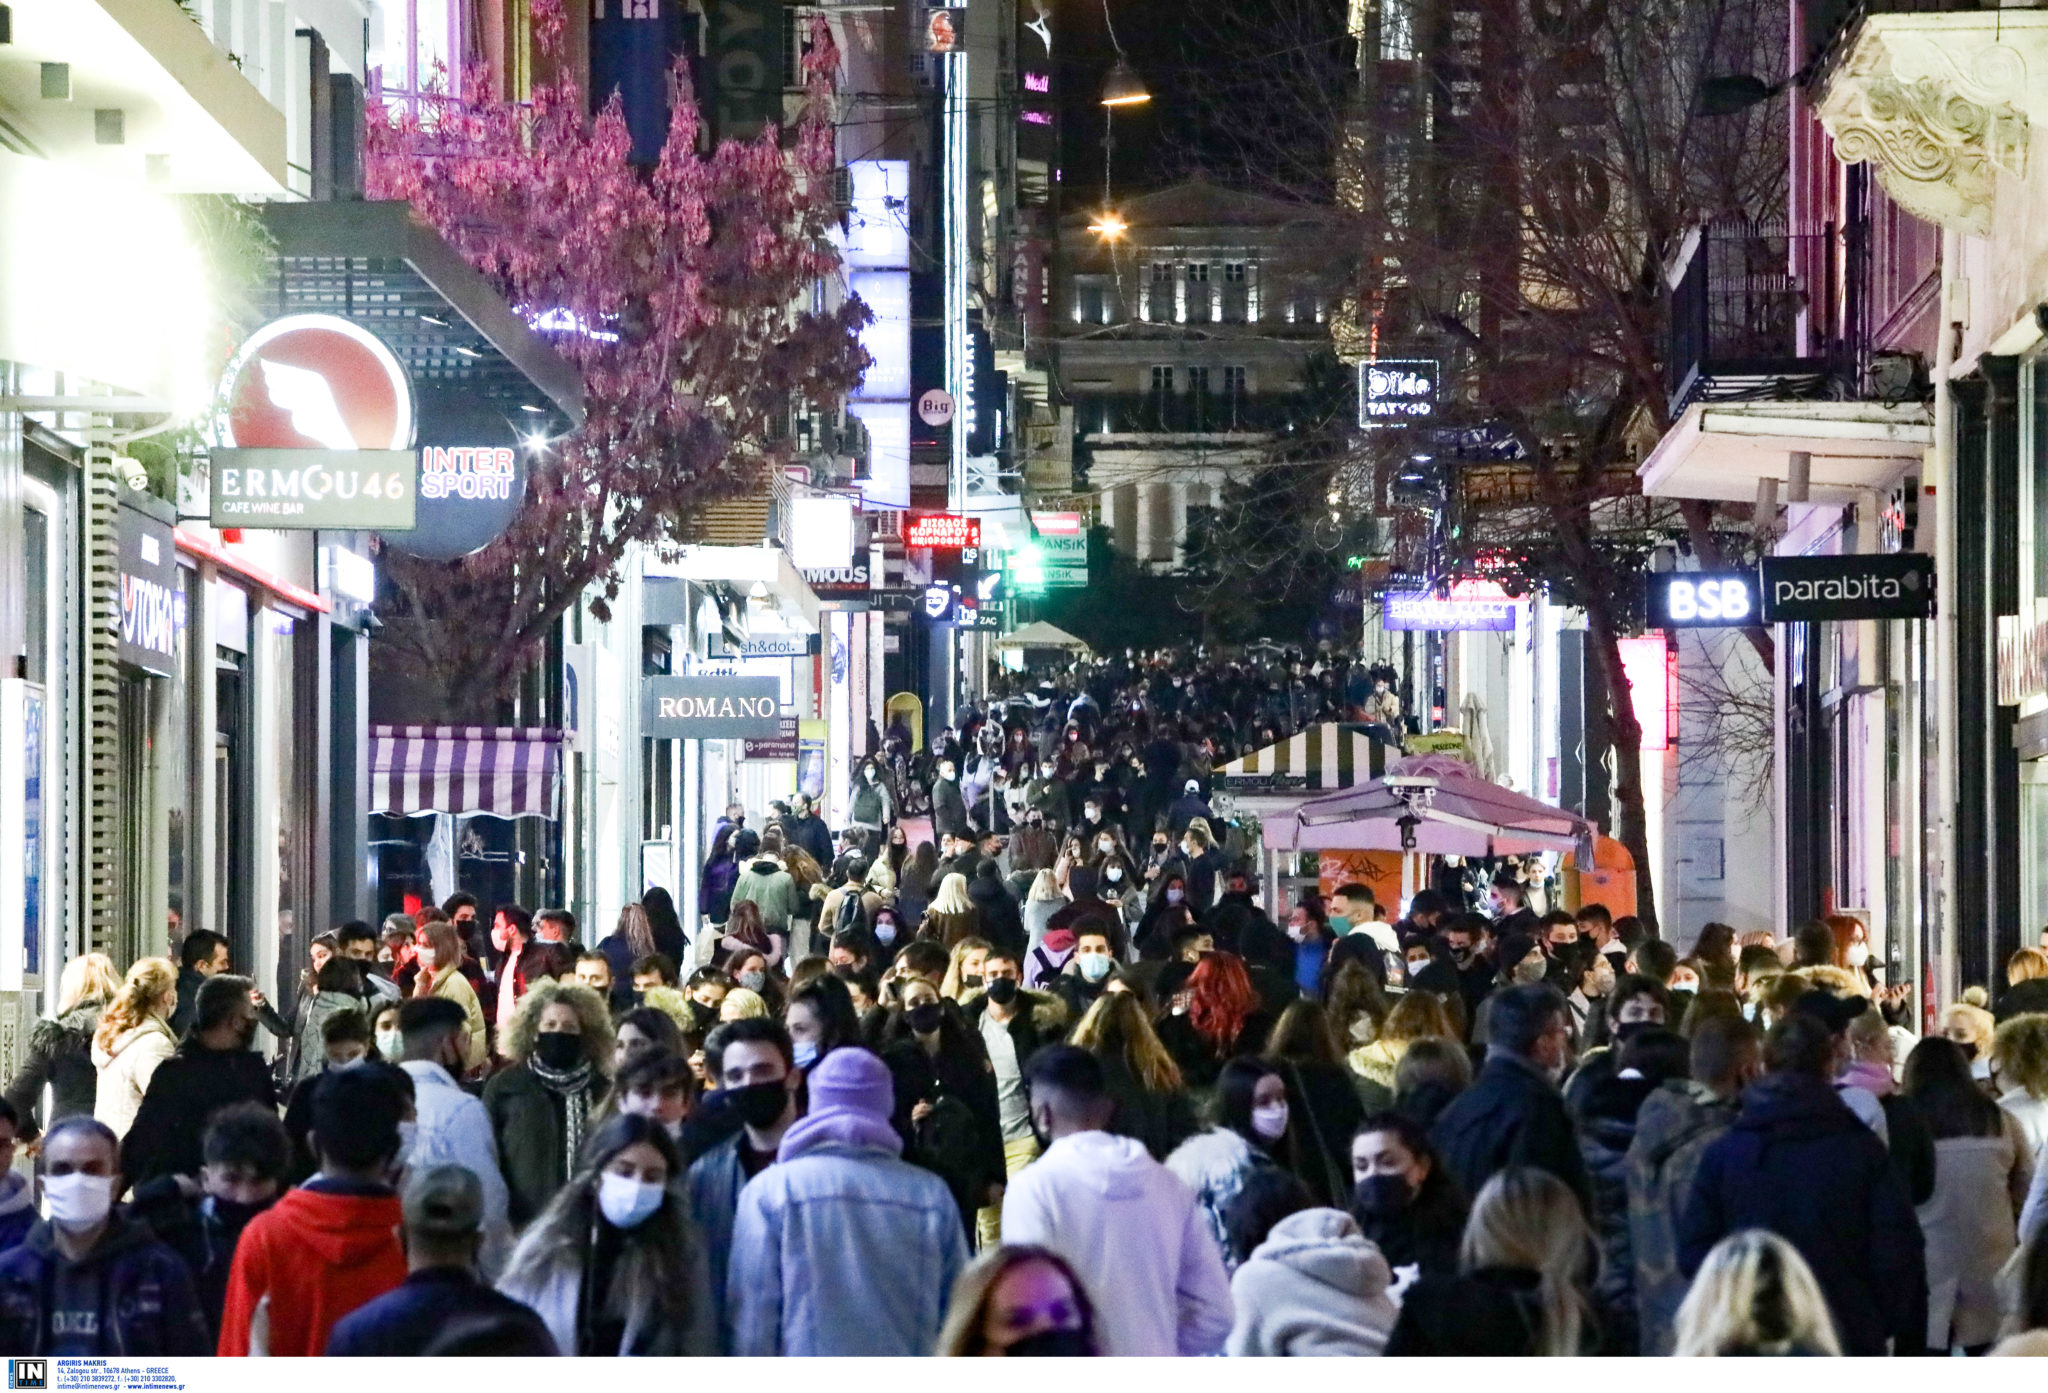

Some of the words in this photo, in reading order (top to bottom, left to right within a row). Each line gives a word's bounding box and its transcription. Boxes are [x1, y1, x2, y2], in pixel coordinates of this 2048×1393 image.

[923, 399, 948, 414] Big
[423, 446, 515, 473] INTER
[421, 472, 514, 500] SPORT
[222, 502, 250, 515] CAFE
[251, 502, 280, 515] WINE
[281, 502, 304, 515] BAR
[803, 565, 868, 583] MOUS
[1669, 580, 1750, 620] BSB
[1775, 574, 1900, 606] parabita
[658, 697, 776, 718] ROMANO
[1226, 777, 1267, 786] ERMOU
